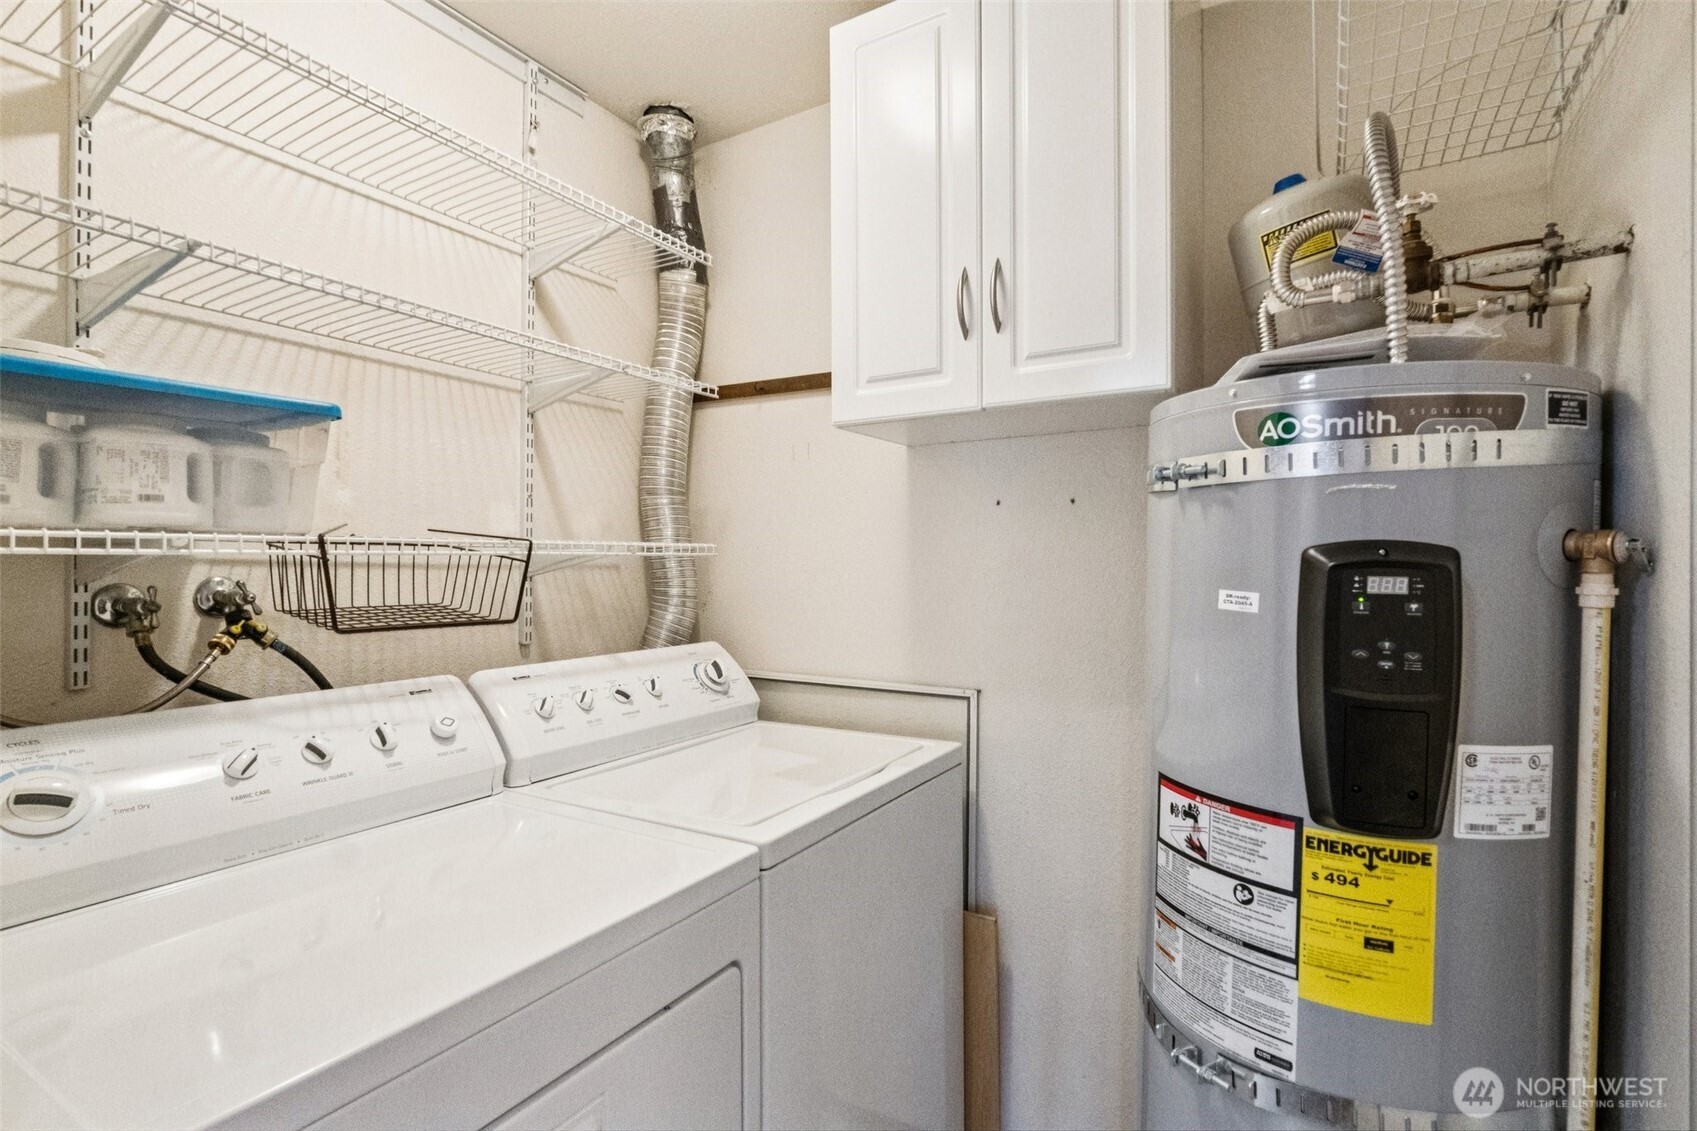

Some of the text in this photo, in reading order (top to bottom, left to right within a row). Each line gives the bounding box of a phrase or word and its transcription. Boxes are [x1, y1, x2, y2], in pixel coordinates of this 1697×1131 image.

[1409, 407, 1503, 416] SIGNATURE
[6, 739, 40, 748] CYCLES
[302, 777, 327, 787] WRINKLE
[231, 789, 271, 801] FABRIC CARE
[113, 803, 151, 815] Timed Dry
[1203, 798, 1231, 812] DANGER
[1311, 872, 1360, 888] $ 494
